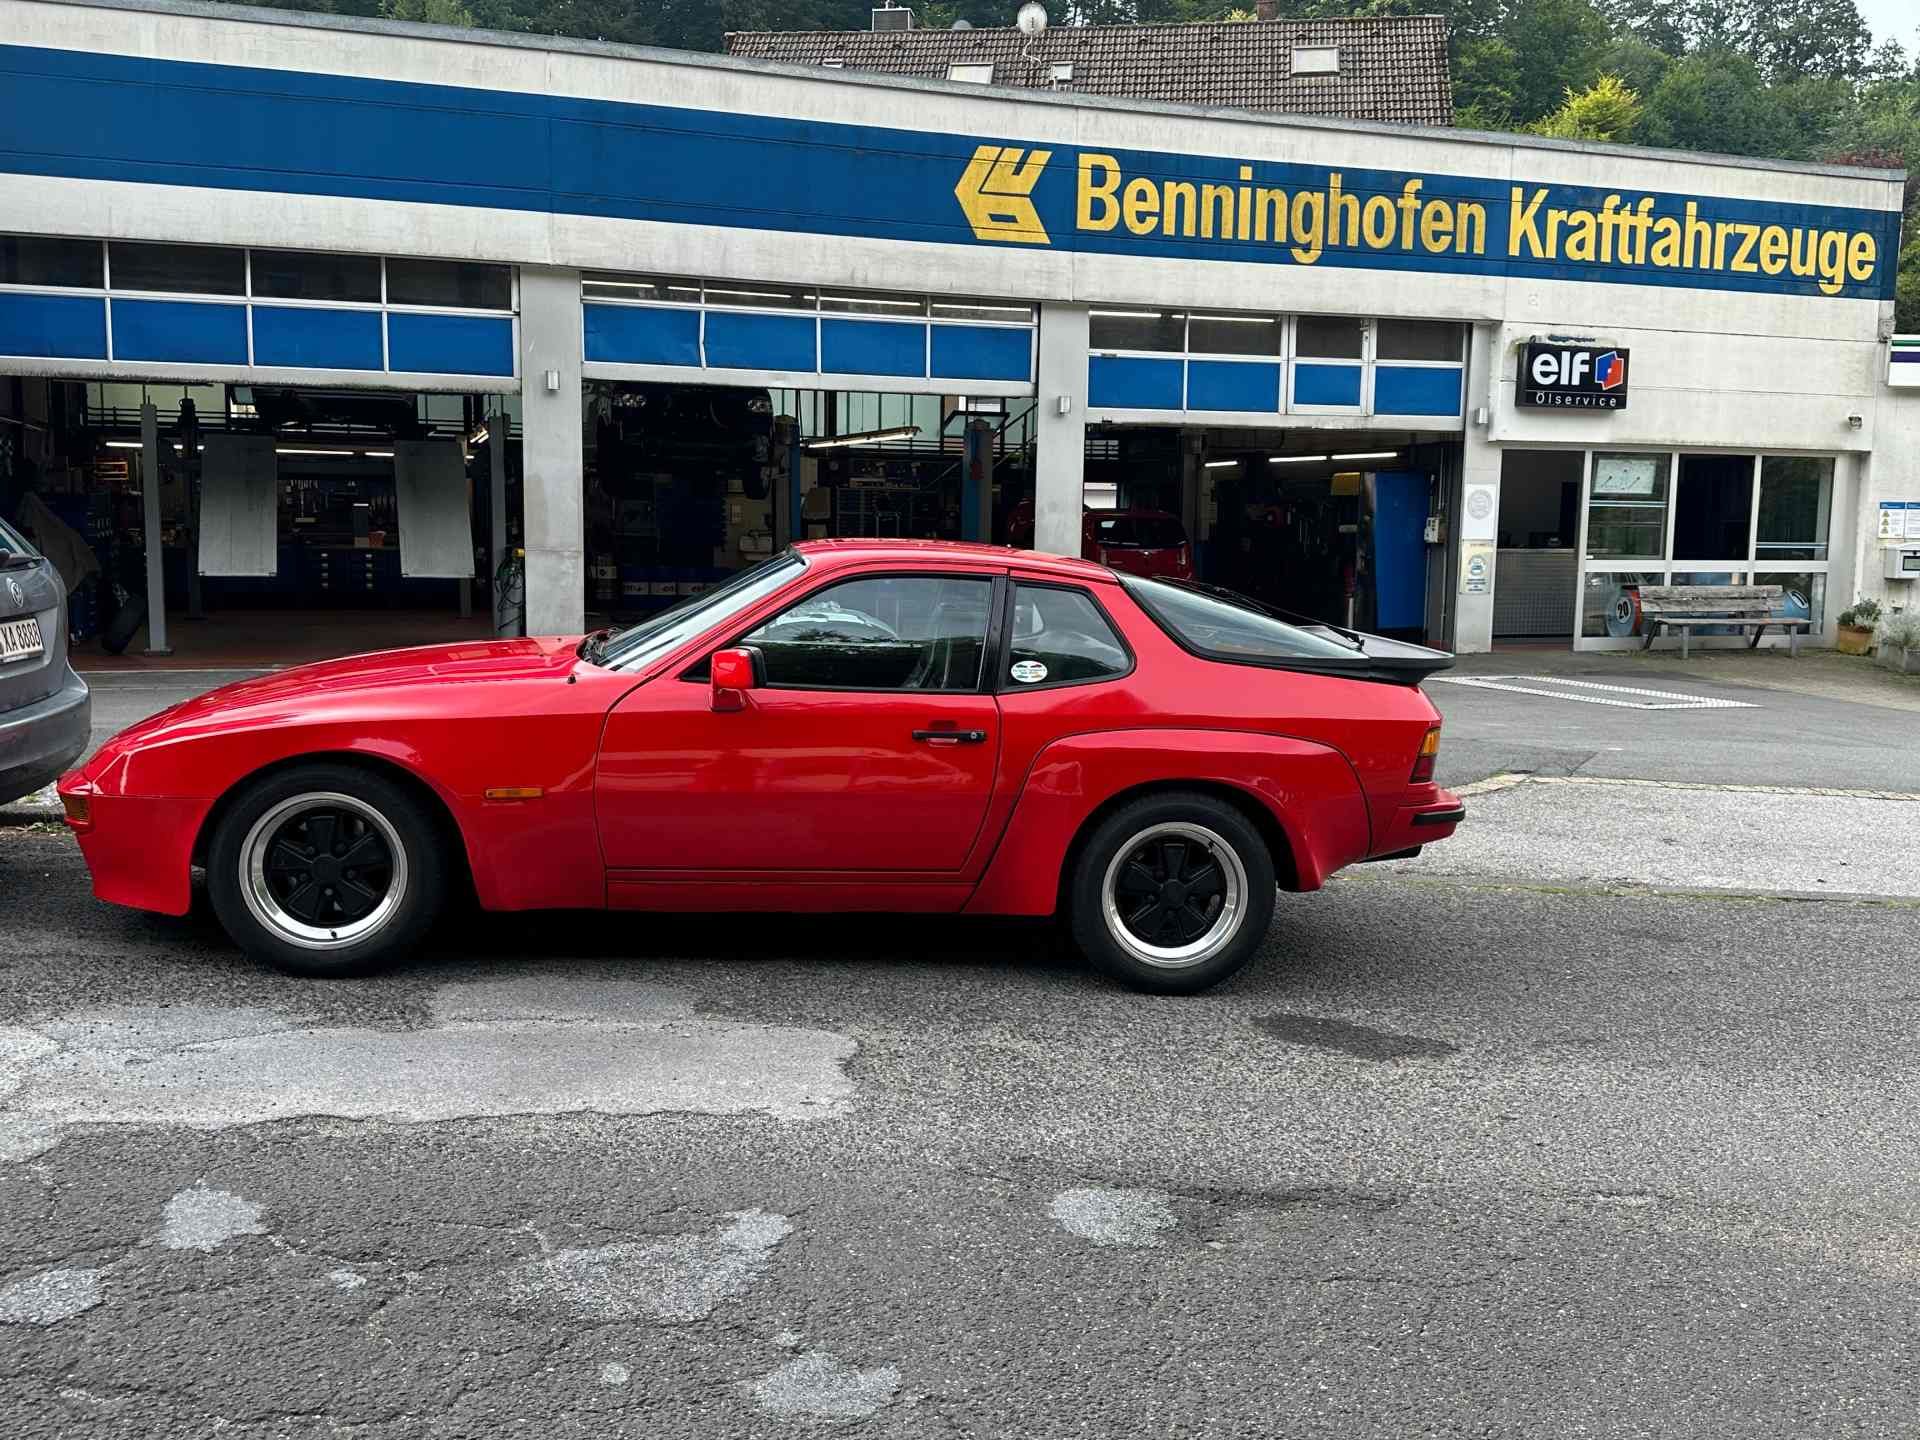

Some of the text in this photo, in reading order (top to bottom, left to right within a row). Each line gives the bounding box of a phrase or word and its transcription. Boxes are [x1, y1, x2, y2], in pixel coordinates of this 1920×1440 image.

[1076, 153, 1876, 295] Benninghofen Kraftfahrzeuge
[1532, 351, 1590, 386] elf
[1536, 391, 1617, 407] Ölservice
